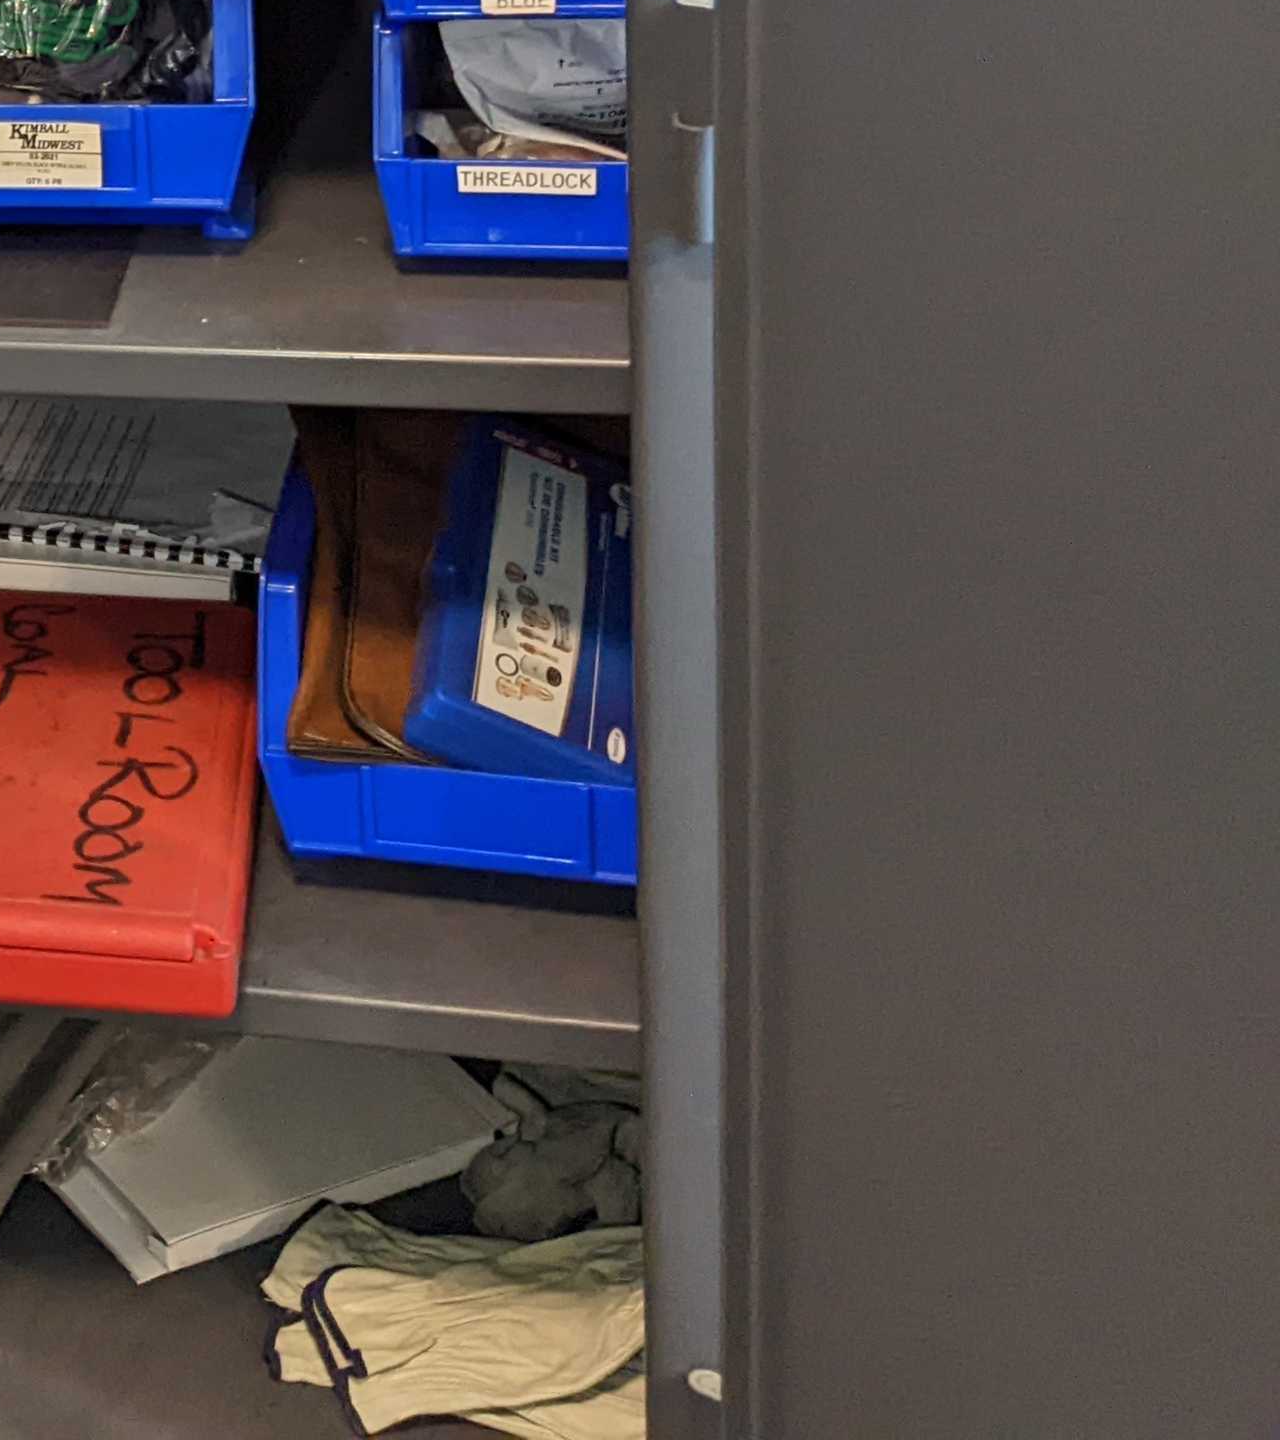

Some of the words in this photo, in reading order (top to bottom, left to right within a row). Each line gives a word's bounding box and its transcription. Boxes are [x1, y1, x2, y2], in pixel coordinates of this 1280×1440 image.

[9, 124, 69, 139] KIMBALL
[21, 134, 84, 150] MIDWEST
[461, 171, 591, 189] THREADLOCK
[113, 610, 207, 748] TOOL
[42, 744, 199, 908] ROOM
